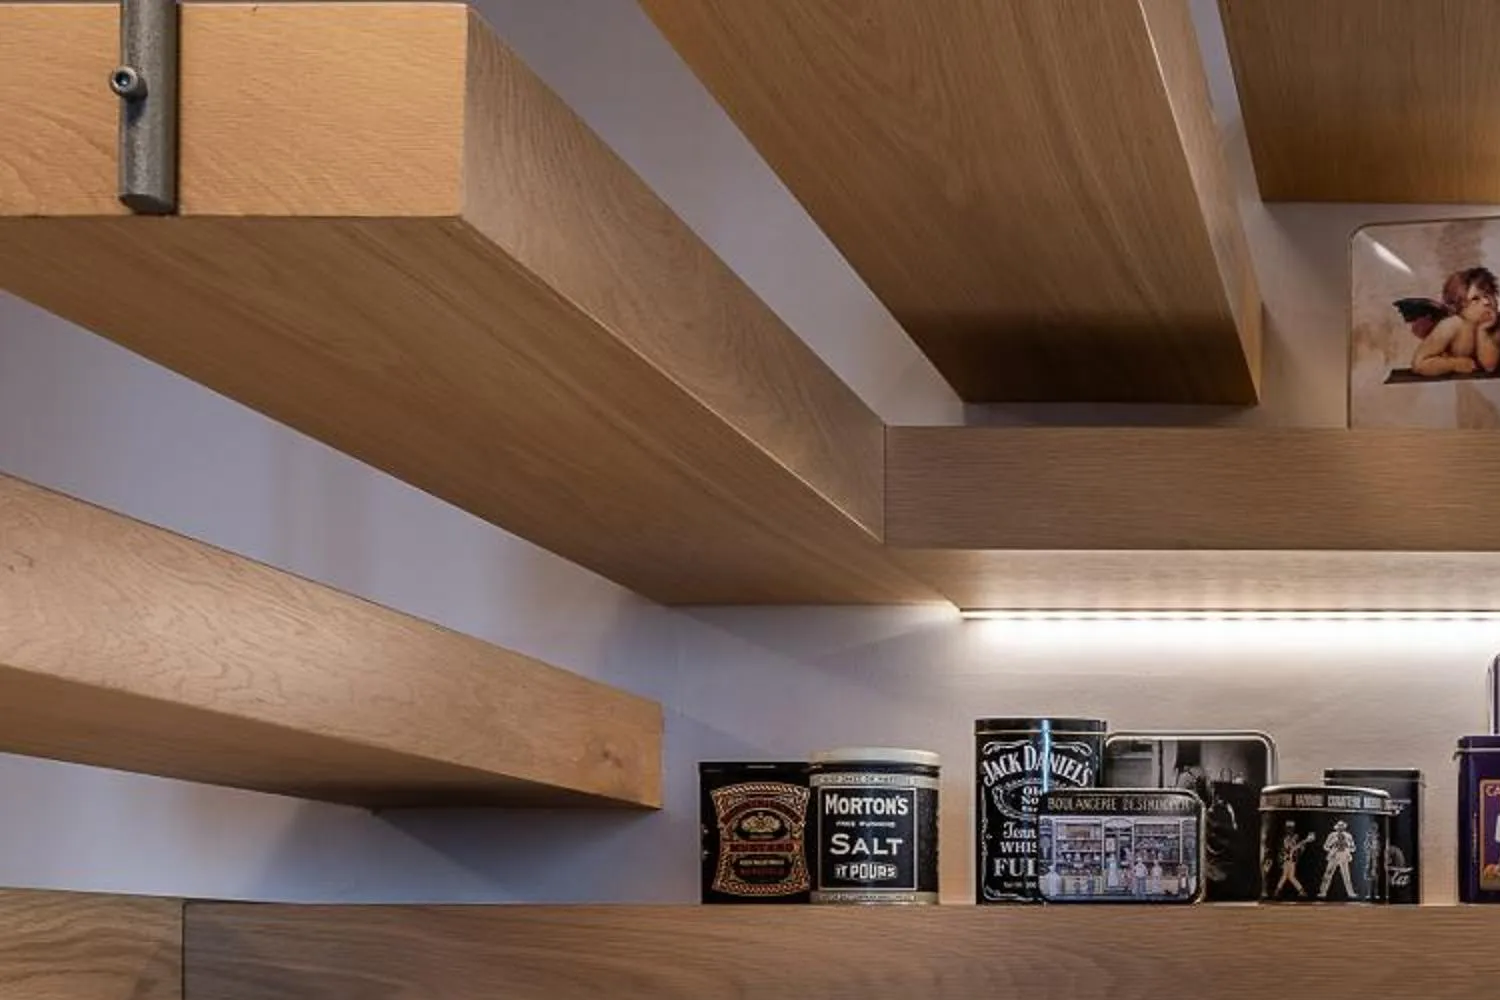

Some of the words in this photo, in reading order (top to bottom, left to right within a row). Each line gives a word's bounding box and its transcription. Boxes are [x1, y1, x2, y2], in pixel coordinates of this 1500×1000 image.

[982, 753, 1022, 786] JACK
[825, 793, 909, 816] MORTON'S
[829, 832, 904, 856] SALT
[835, 864, 849, 879] IT
[849, 862, 897, 880] POURS
